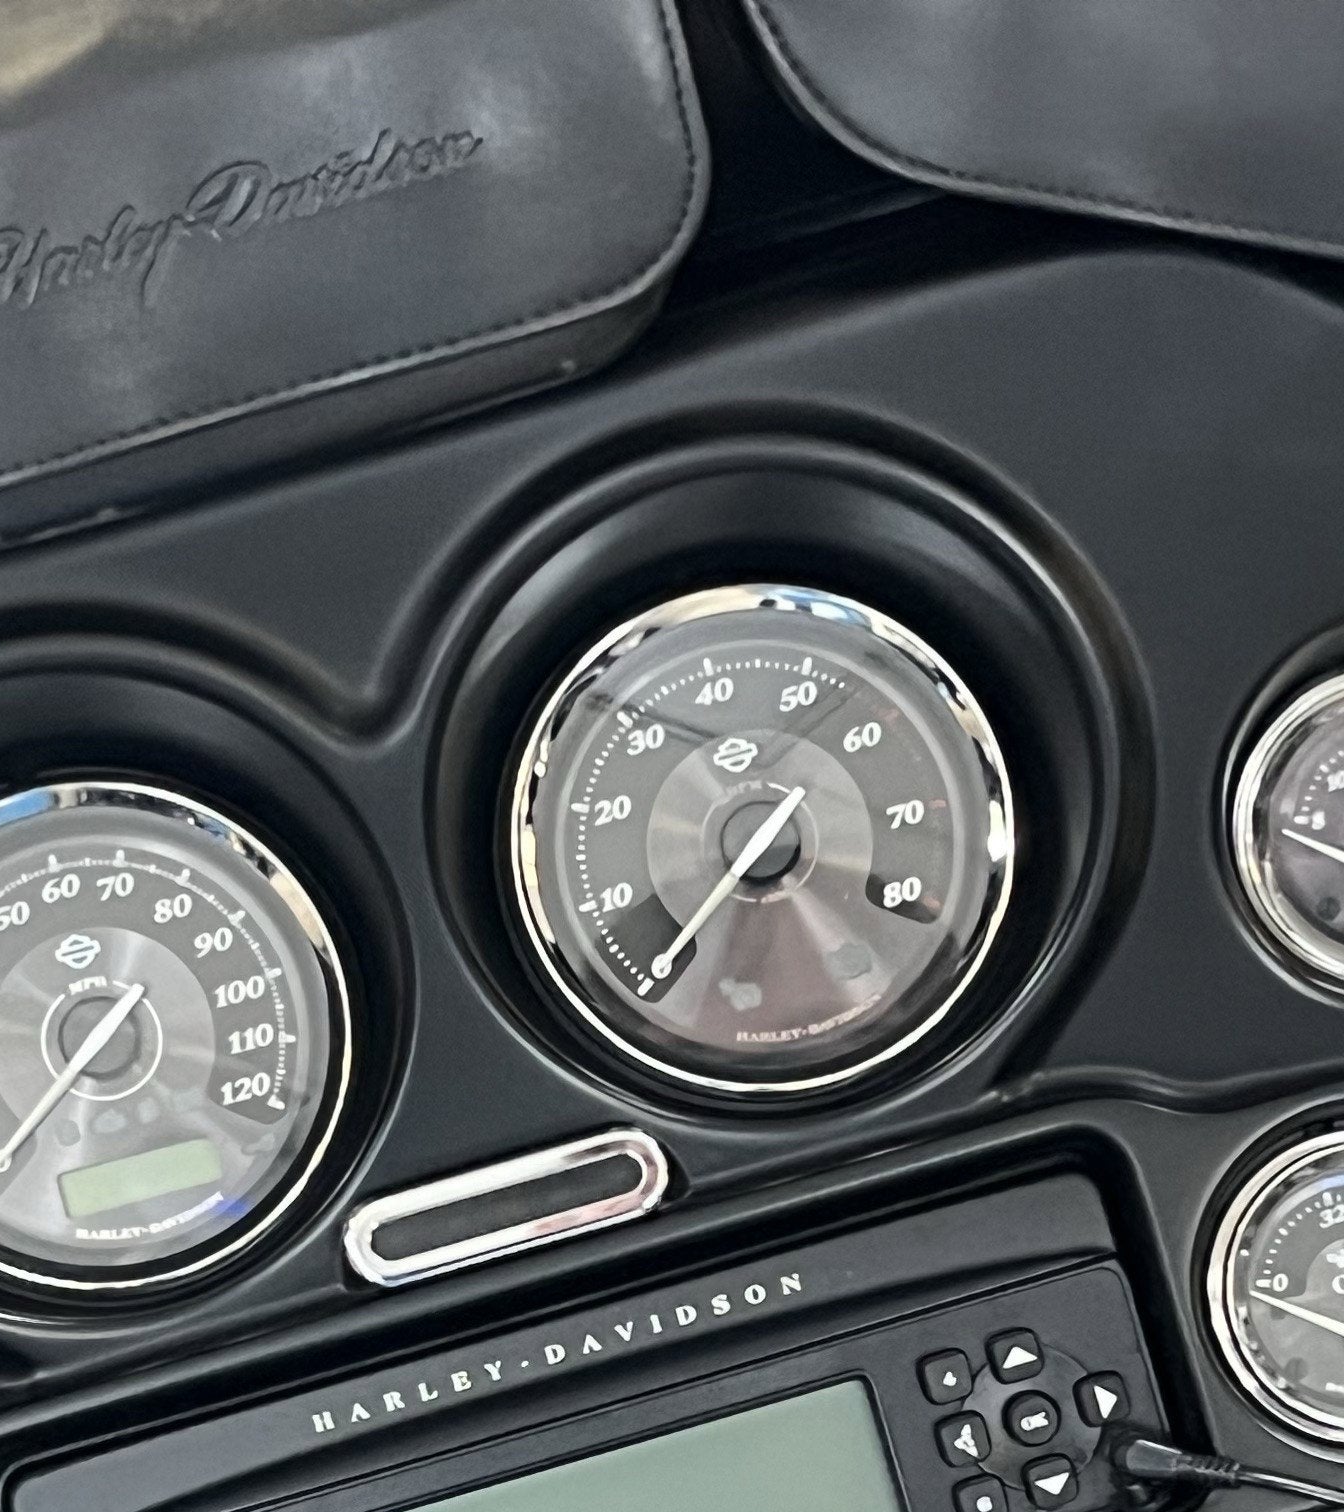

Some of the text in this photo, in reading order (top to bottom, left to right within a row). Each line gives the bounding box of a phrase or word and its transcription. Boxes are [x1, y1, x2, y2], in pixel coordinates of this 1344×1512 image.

[695, 677, 734, 705] 40
[779, 682, 817, 712] 50
[626, 724, 665, 756] 30
[843, 722, 882, 753] 60
[594, 795, 632, 826] 20
[886, 800, 925, 830] 70
[42, 873, 81, 903] 60
[96, 871, 134, 901] 70
[600, 882, 633, 908] 10
[882, 877, 922, 908] 80
[153, 893, 192, 924] 80
[194, 927, 233, 957] 90
[214, 975, 266, 1008] 100
[227, 1023, 274, 1055] 110
[220, 1072, 271, 1106] 120
[1272, 1273, 1289, 1291] 0
